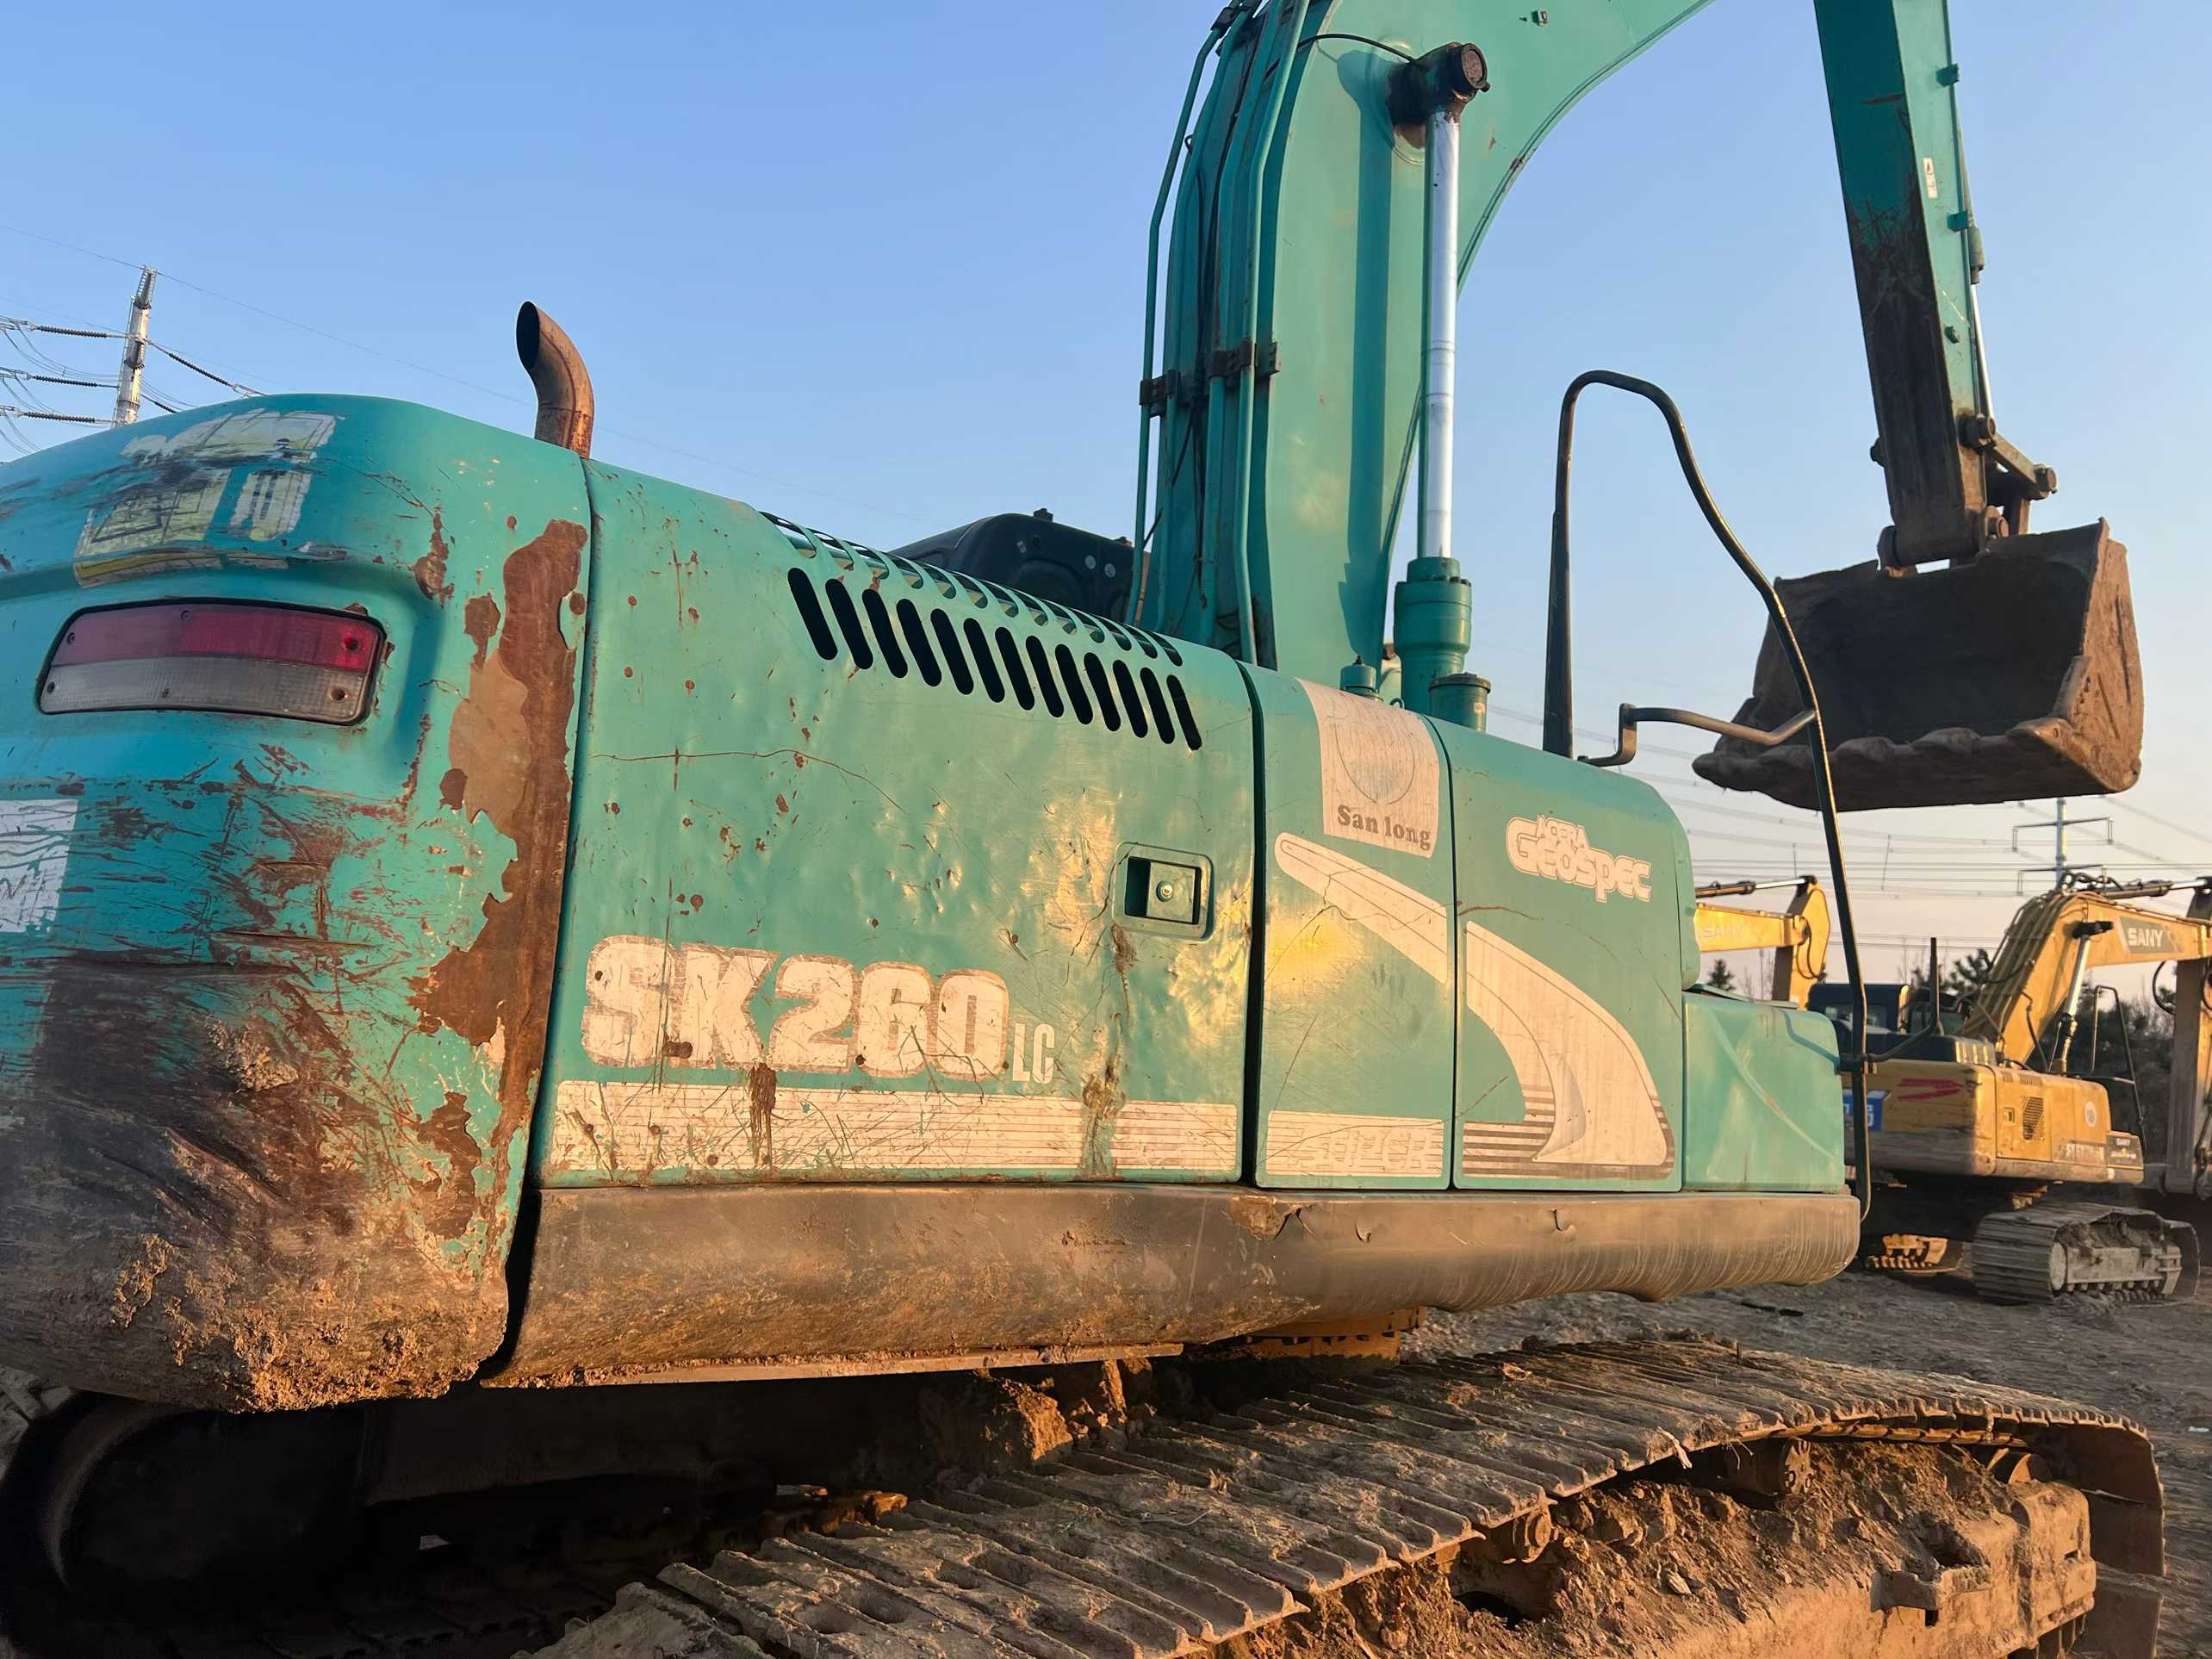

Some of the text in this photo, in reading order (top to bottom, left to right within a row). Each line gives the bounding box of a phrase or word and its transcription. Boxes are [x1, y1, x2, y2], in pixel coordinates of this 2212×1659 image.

[1338, 805, 1430, 851] San long
[2128, 928, 2163, 947] SANY
[582, 935, 1054, 1083] SK260 LC
